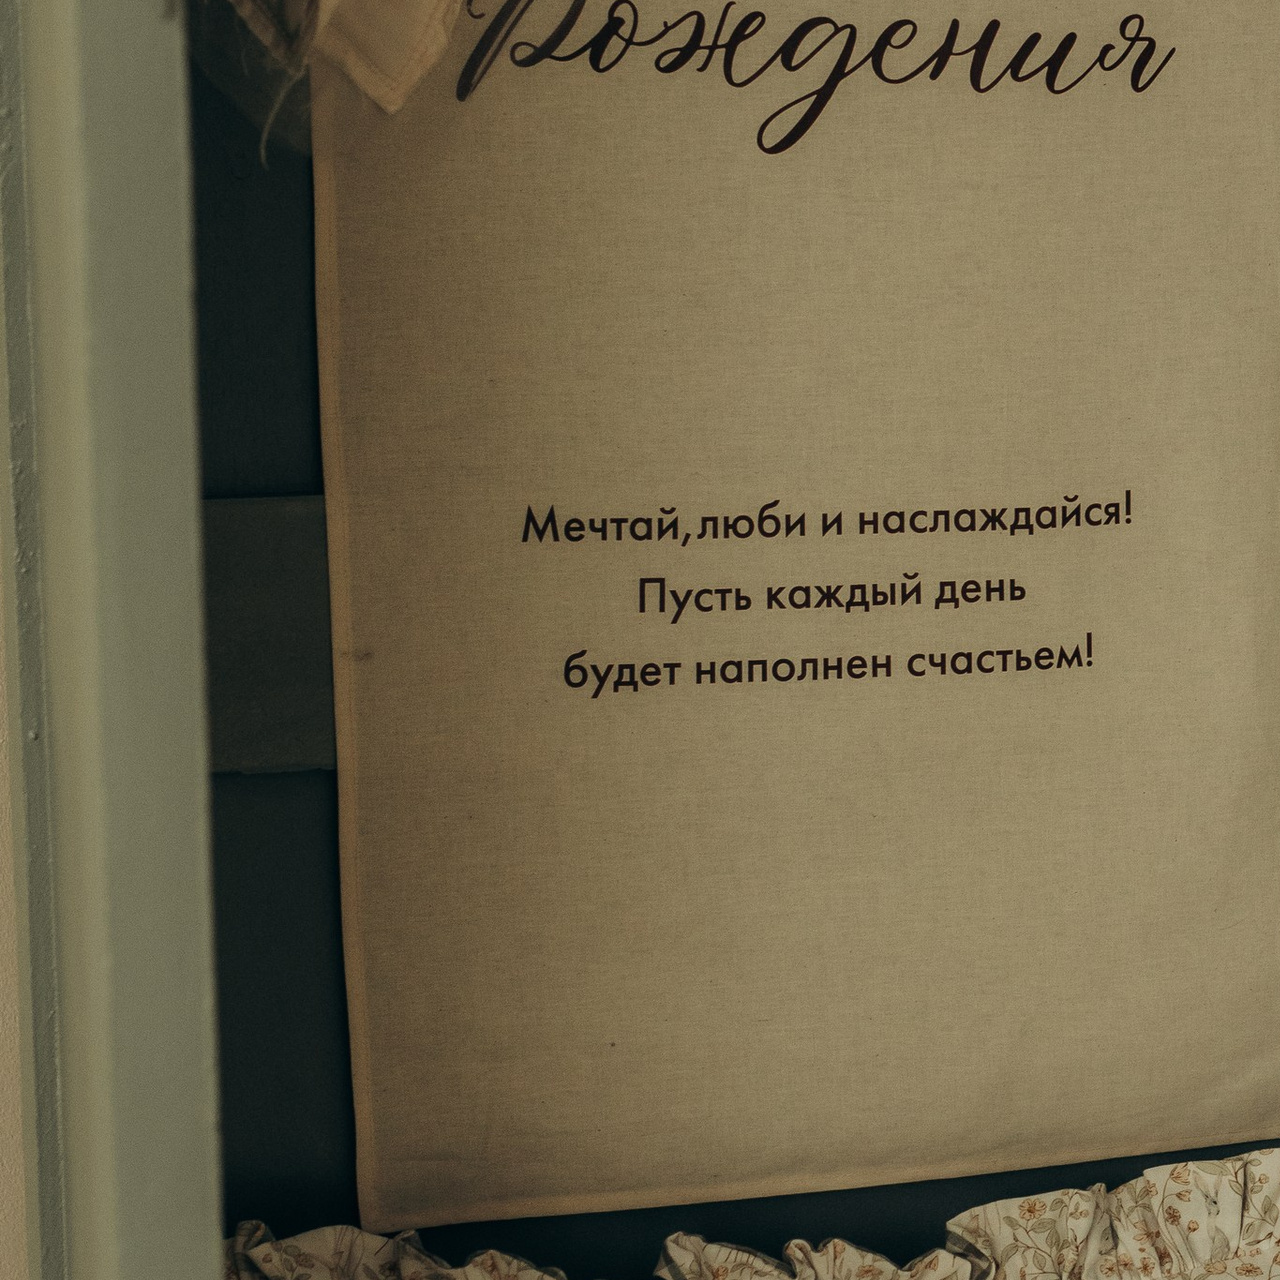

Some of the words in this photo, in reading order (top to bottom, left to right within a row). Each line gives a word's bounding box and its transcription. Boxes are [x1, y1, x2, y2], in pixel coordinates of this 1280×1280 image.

[822, 511, 842, 537] и
[859, 490, 1131, 537] наслаждайся!
[639, 577, 751, 625] Пусть
[767, 572, 921, 613] каждый
[935, 579, 1026, 610] день
[564, 650, 681, 699] будет
[696, 655, 891, 684] наполнен
[907, 632, 1093, 676] счастьем!
